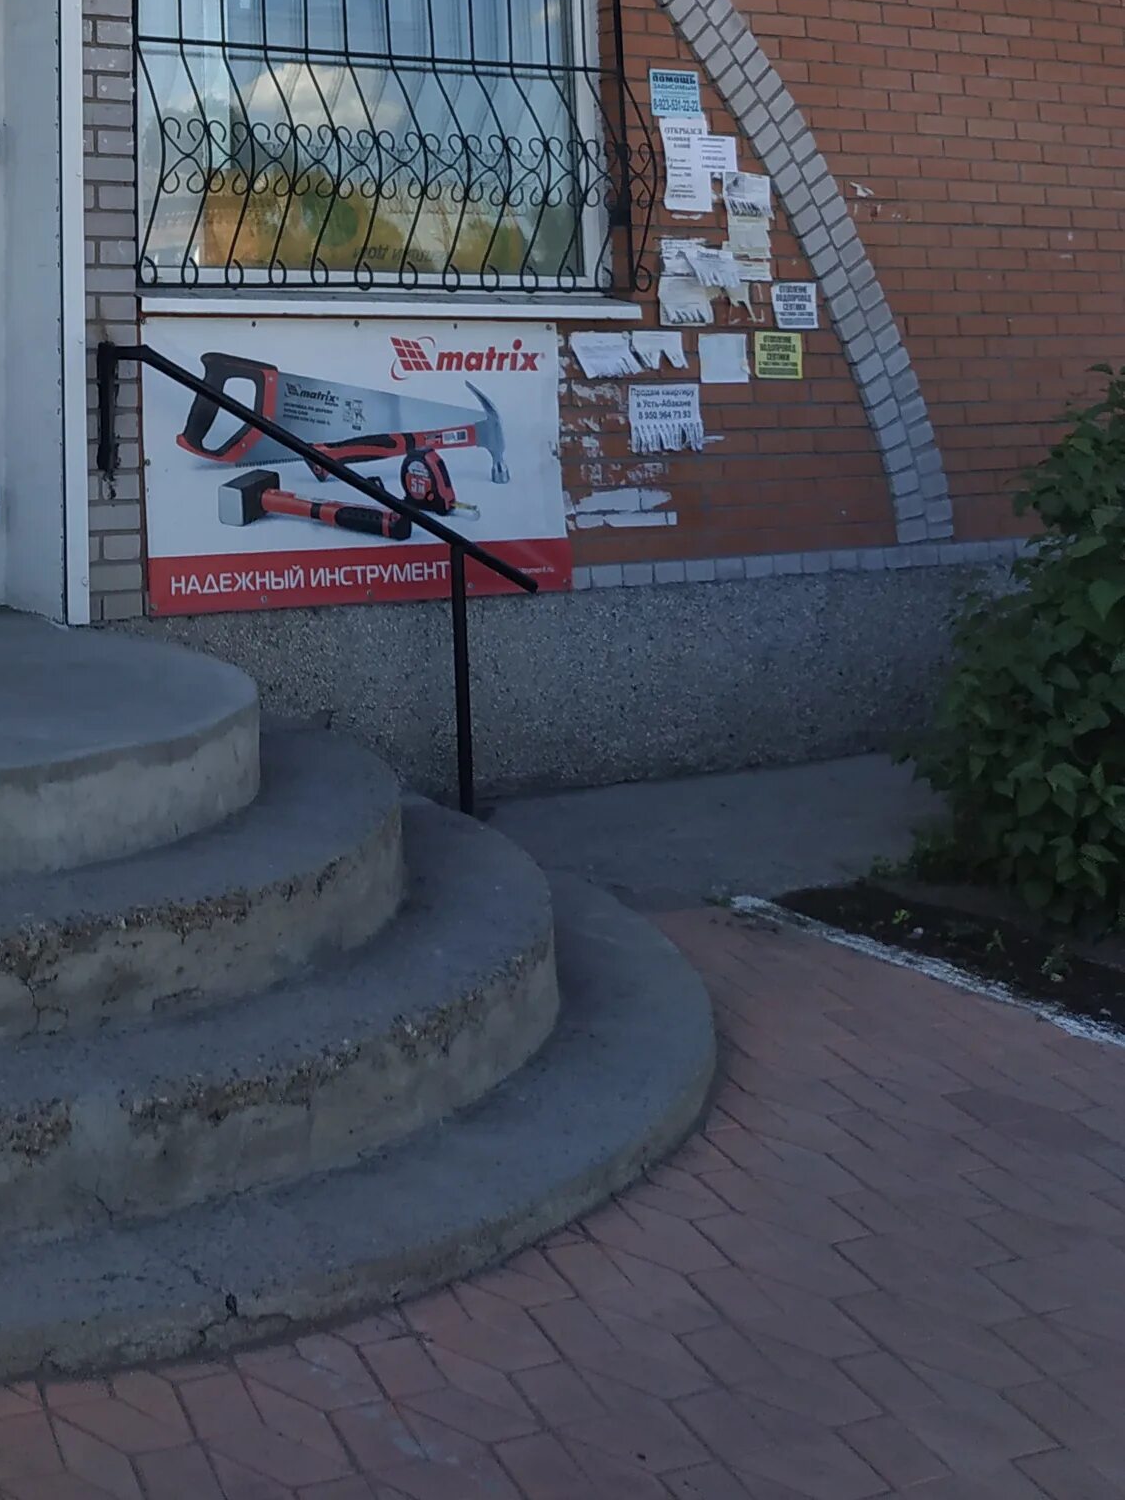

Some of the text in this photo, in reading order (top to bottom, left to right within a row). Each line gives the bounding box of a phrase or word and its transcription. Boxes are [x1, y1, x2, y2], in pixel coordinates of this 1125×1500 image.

[436, 338, 541, 372] matrix
[170, 560, 451, 596] НАДЕЖНЫЙ ИНСТРУМЕНТ
